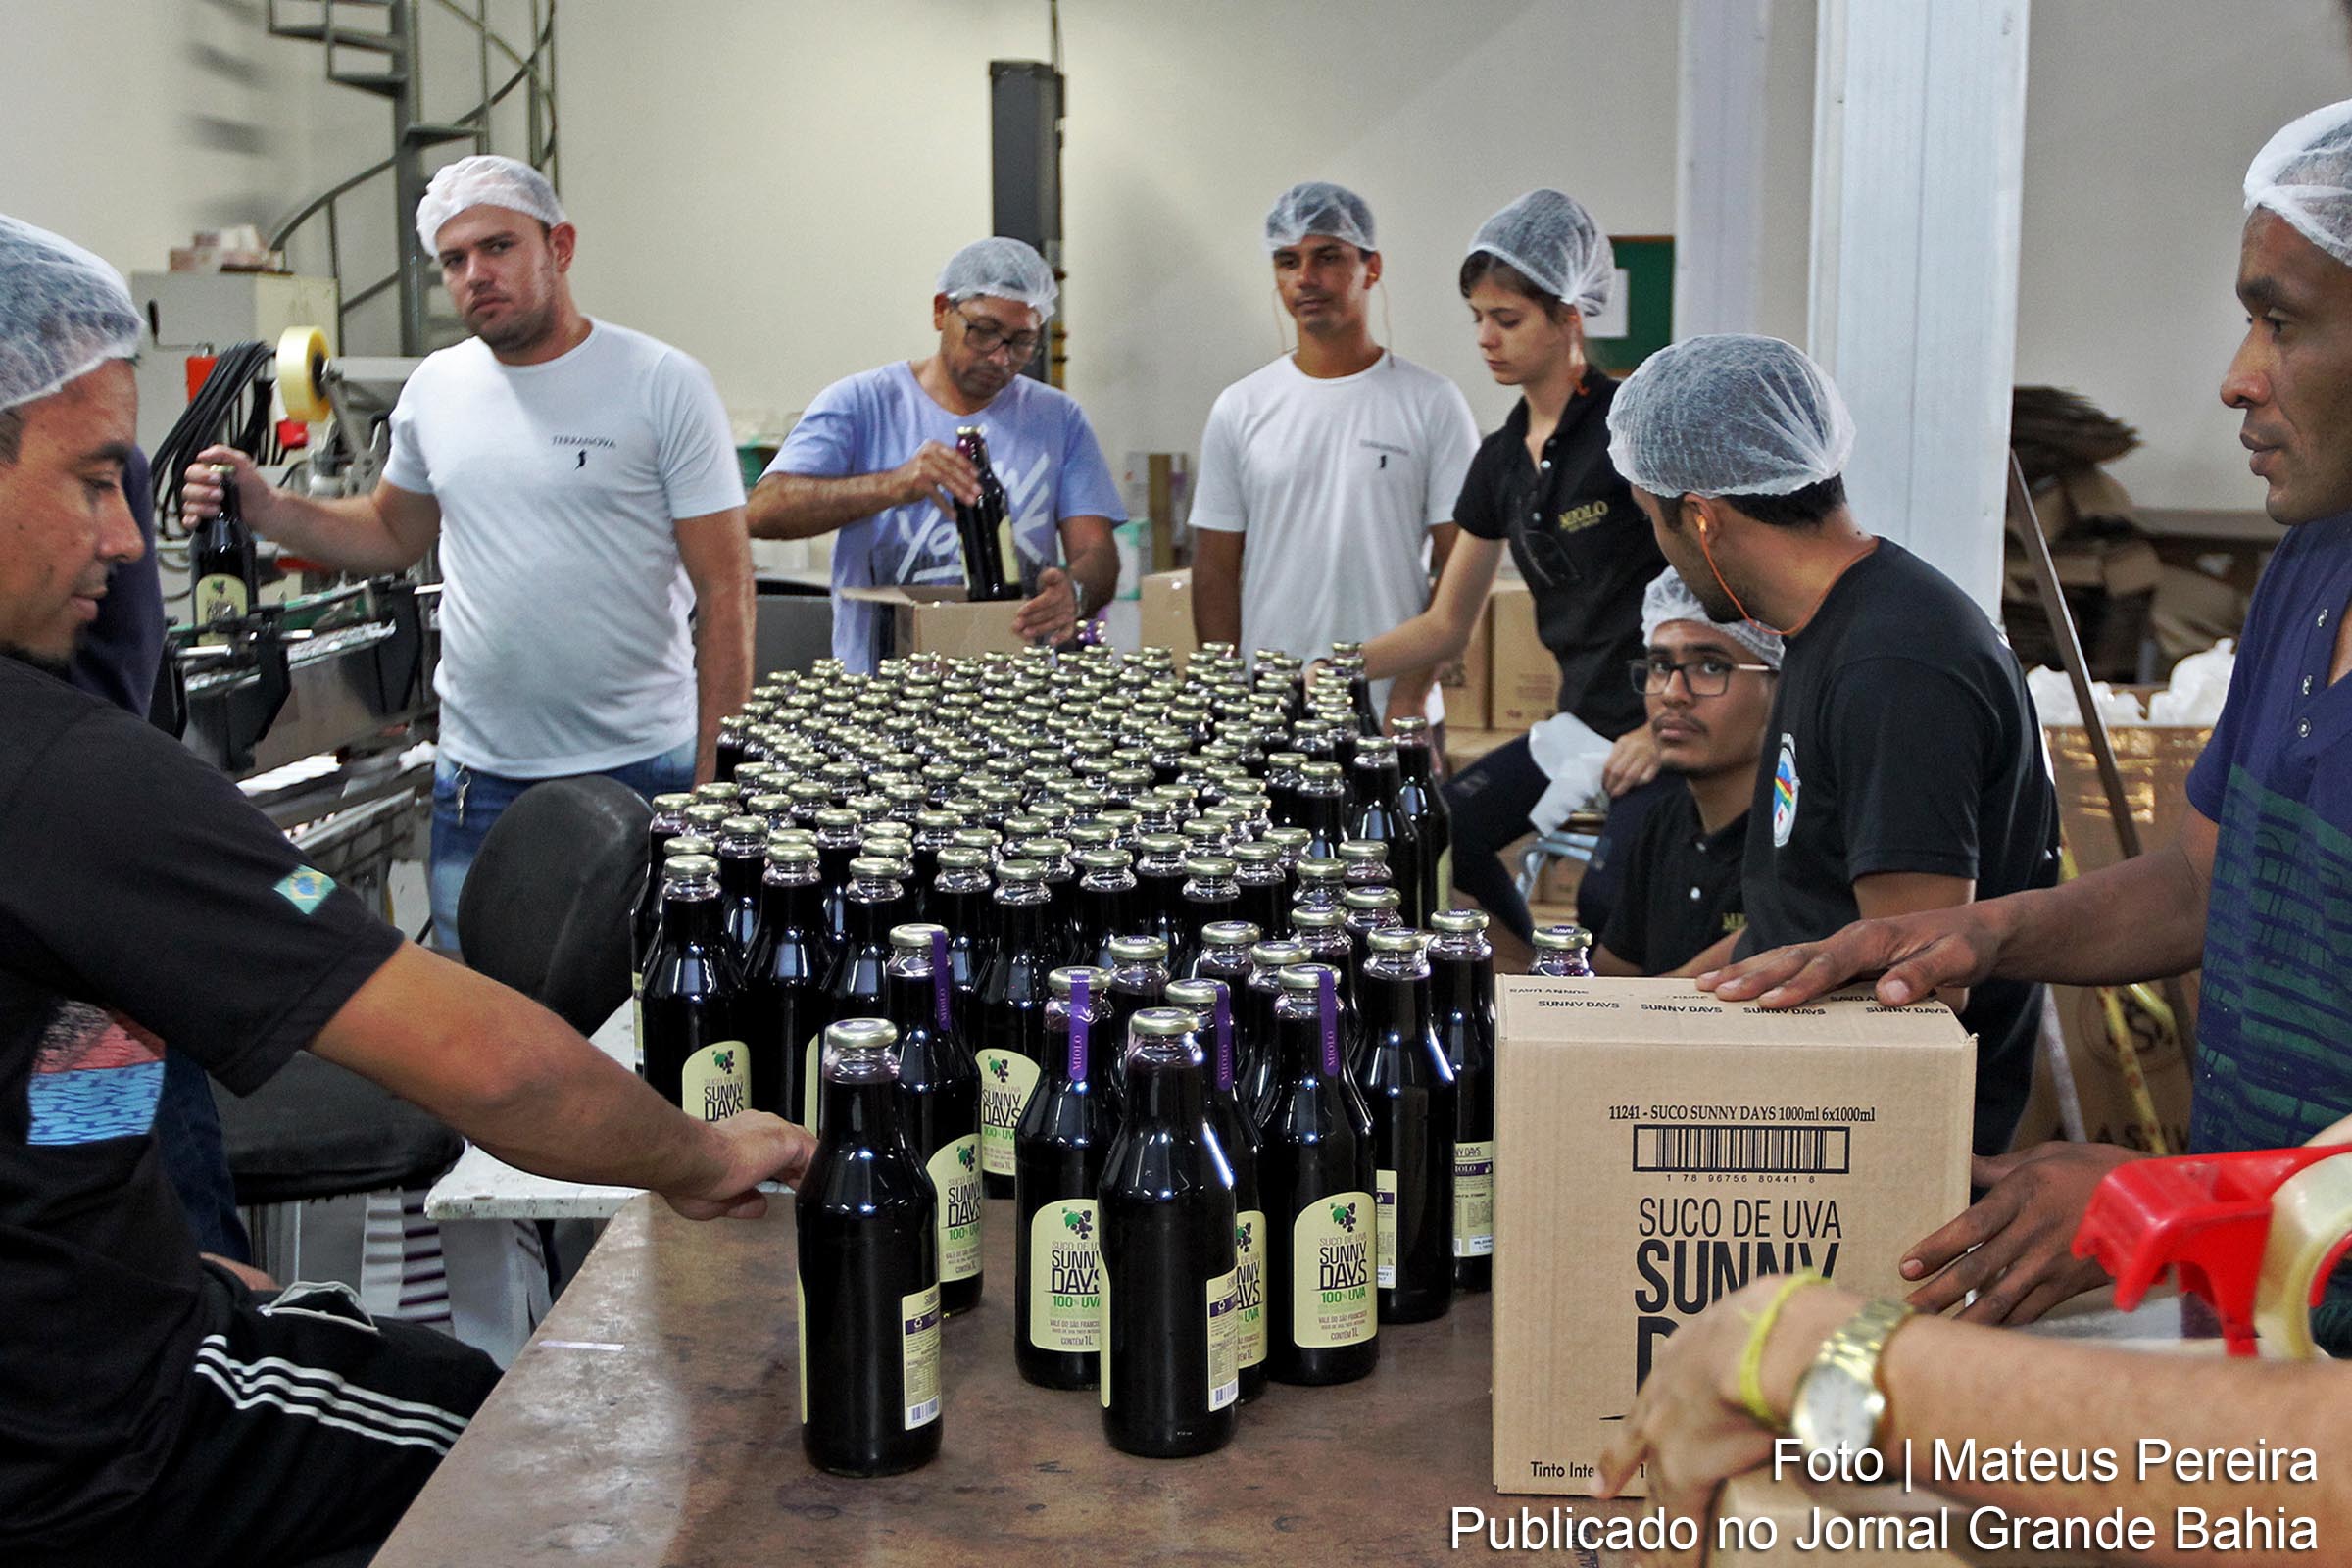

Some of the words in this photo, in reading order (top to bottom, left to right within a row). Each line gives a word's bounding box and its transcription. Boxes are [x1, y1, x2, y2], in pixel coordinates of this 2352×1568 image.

[1073, 1035, 1083, 1071] MIOLO
[1327, 1030, 1336, 1066] MIOLO
[704, 1081, 744, 1102] SUNNY
[982, 1089, 1021, 1108] SUNNY
[704, 1097, 745, 1122] DAYS
[983, 1103, 1022, 1128] DAYS
[1609, 1105, 1641, 1120] 11241
[1650, 1105, 1688, 1121] SUCO
[1690, 1105, 1738, 1121] SUNNY
[1740, 1106, 1776, 1121] DAYS
[1779, 1106, 1820, 1122] 1000ml
[1822, 1107, 1876, 1122] 6x1000ml
[1455, 1164, 1476, 1173] IOLO
[948, 1196, 981, 1228] DAYS
[1639, 1197, 1722, 1238] SUCO
[1733, 1199, 1772, 1238] DE
[1783, 1200, 1843, 1239] UVA
[1319, 1241, 1367, 1265] SUNNY
[1237, 1261, 1261, 1285] NNY
[1319, 1259, 1367, 1290] DAYS
[1237, 1280, 1261, 1308] AYS
[1348, 1287, 1366, 1301] UVA
[1530, 1461, 1566, 1478] Tinto
[1570, 1461, 1595, 1478] Inte
